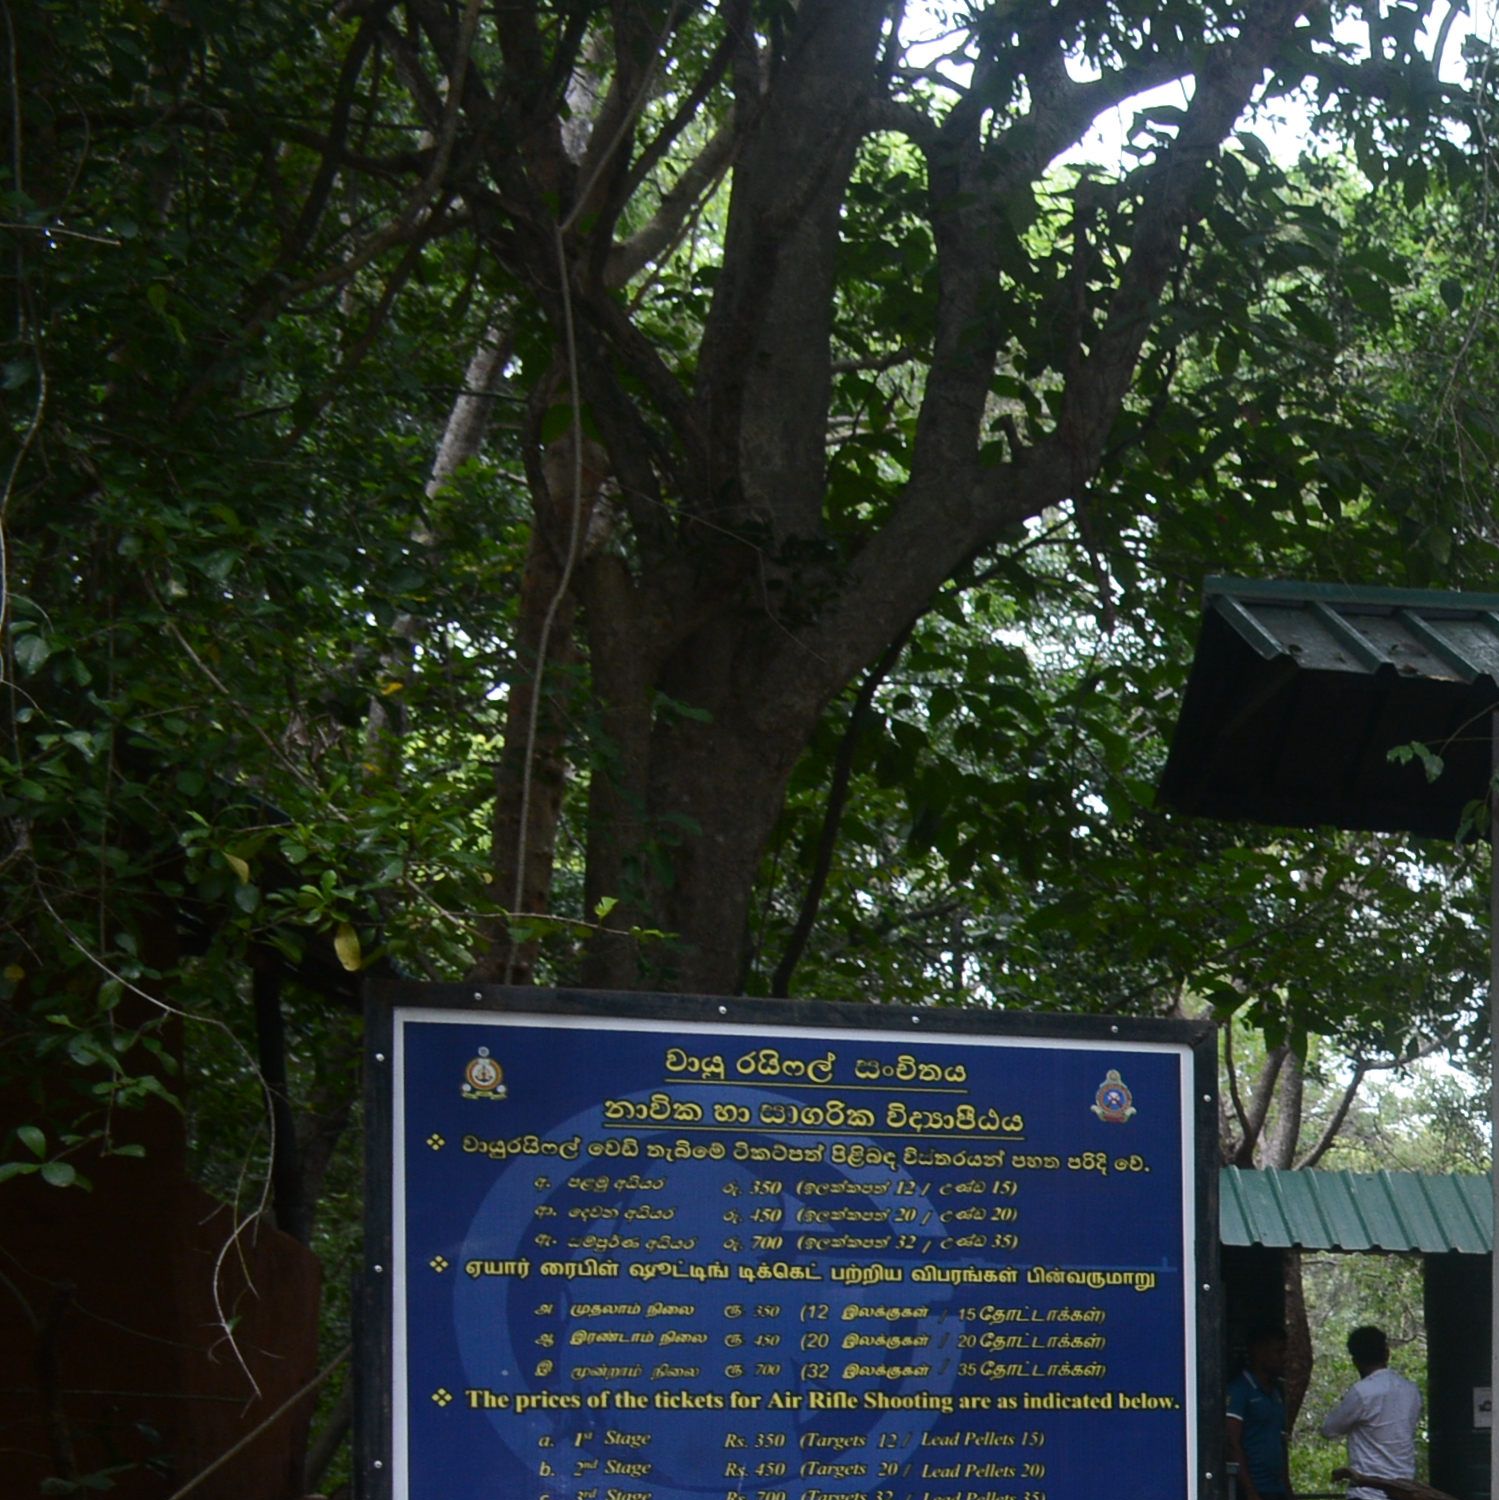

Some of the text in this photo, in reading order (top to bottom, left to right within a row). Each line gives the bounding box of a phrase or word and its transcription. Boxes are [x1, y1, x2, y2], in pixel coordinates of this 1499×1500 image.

[666, 1049, 726, 1081] වායු
[734, 1050, 835, 1085] රයිෆල්
[605, 1094, 702, 1120] නාවික
[714, 1105, 749, 1122] හා
[758, 1100, 874, 1129] සාගරික
[750, 1181, 782, 1194] 350
[897, 1181, 915, 1194] 12
[993, 1181, 1019, 1195] 15)
[751, 1209, 782, 1222] 450
[895, 1208, 916, 1221] 20
[991, 1207, 1018, 1221] 20)
[753, 1236, 782, 1249] 700
[896, 1235, 916, 1249] 32
[992, 1234, 1019, 1248] 35)
[466, 1258, 529, 1278] ஏயார்
[540, 1259, 619, 1279] ரைபிள்
[832, 1264, 901, 1285] பற்றிய
[912, 1265, 1017, 1285] விபரங்கள்
[1027, 1267, 1154, 1291] பின்வருமாறு
[646, 1302, 694, 1317] நிலை
[754, 1306, 780, 1317] 350
[800, 1305, 828, 1321] (12
[659, 1331, 707, 1345] நிலை
[755, 1335, 780, 1346] 450
[801, 1333, 829, 1350] (20
[757, 1364, 780, 1375] 700
[801, 1364, 829, 1380] (32
[466, 1391, 1181, 1412] The prices of the tickets for Air Rifle Shooting are as indicated below.
[539, 1437, 555, 1446] a.
[605, 1431, 651, 1448] Stage
[725, 1434, 748, 1447] Rs.
[755, 1434, 785, 1447] 350
[800, 1433, 865, 1449] (Targets
[880, 1434, 897, 1447] 12
[922, 1432, 960, 1446] Lead
[964, 1432, 1014, 1445] Pellets
[1022, 1432, 1046, 1446] 15)
[539, 1462, 556, 1476] b.
[605, 1460, 651, 1477] Stage
[725, 1463, 749, 1479] Rs.
[755, 1463, 785, 1476] 450
[800, 1462, 866, 1478] (Targets
[879, 1462, 898, 1476] 20
[922, 1464, 961, 1477] Lead
[965, 1464, 1015, 1477] Pellets
[1021, 1464, 1047, 1477] 20)
